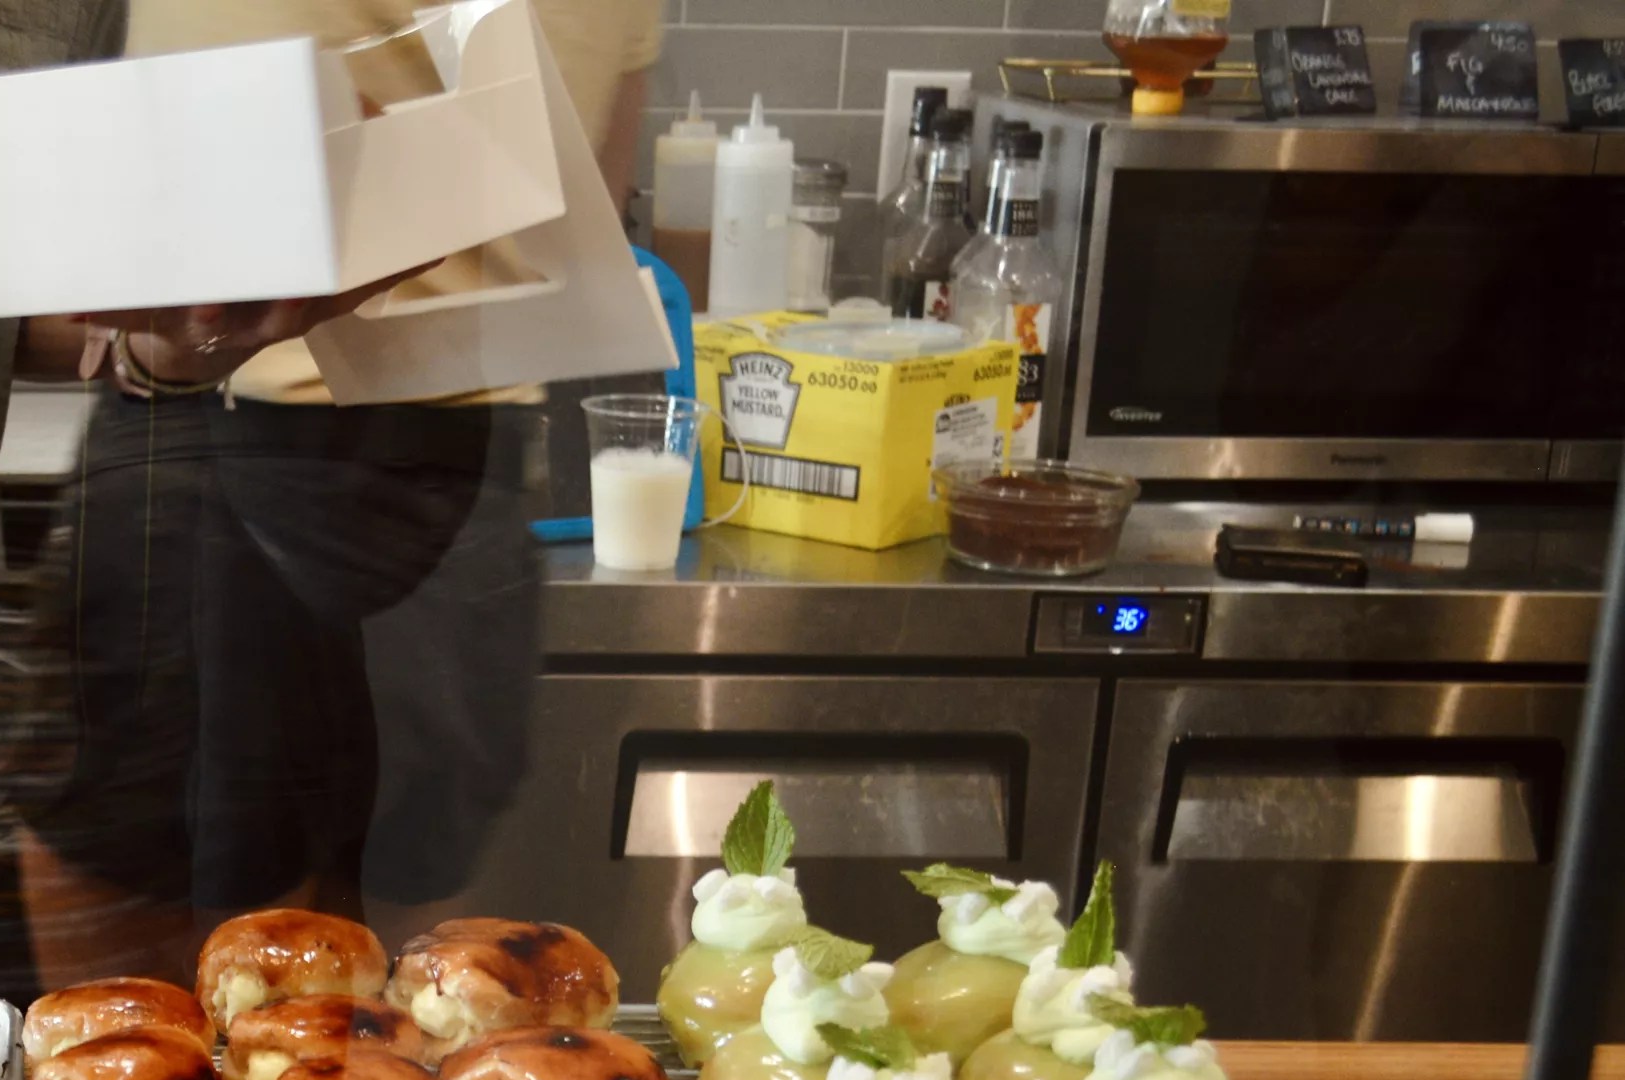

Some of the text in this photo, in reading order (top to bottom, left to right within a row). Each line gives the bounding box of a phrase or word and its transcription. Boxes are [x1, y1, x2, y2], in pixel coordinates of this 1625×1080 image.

[739, 361, 783, 379] HEINZ
[808, 372, 858, 391] 63050
[737, 385, 781, 400] YELLOW
[1113, 607, 1139, 631] 36
